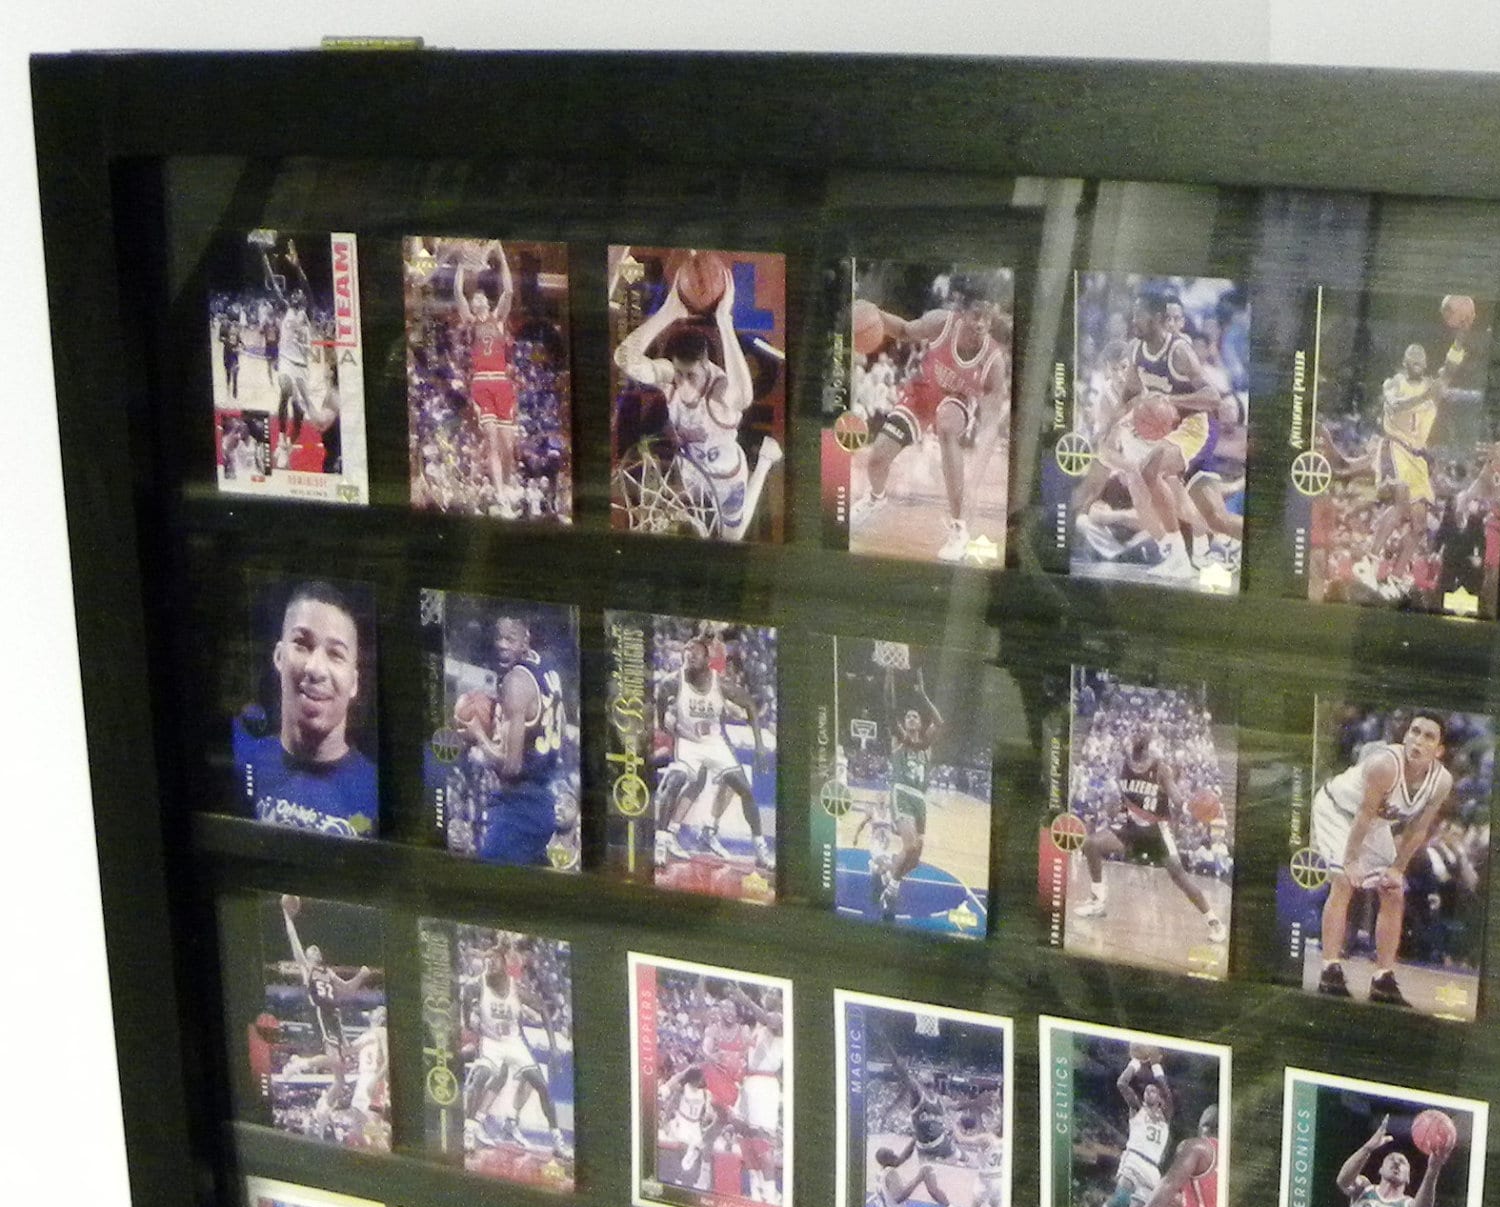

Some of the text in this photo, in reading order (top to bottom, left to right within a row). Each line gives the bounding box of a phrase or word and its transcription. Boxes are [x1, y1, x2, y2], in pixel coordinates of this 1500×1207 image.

[333, 241, 352, 341] TEAM
[642, 990, 654, 1077] CLIPPERS
[851, 1029, 863, 1095] MAGIC
[1055, 1056, 1069, 1136] CELTICS
[1144, 1126, 1163, 1144] 31
